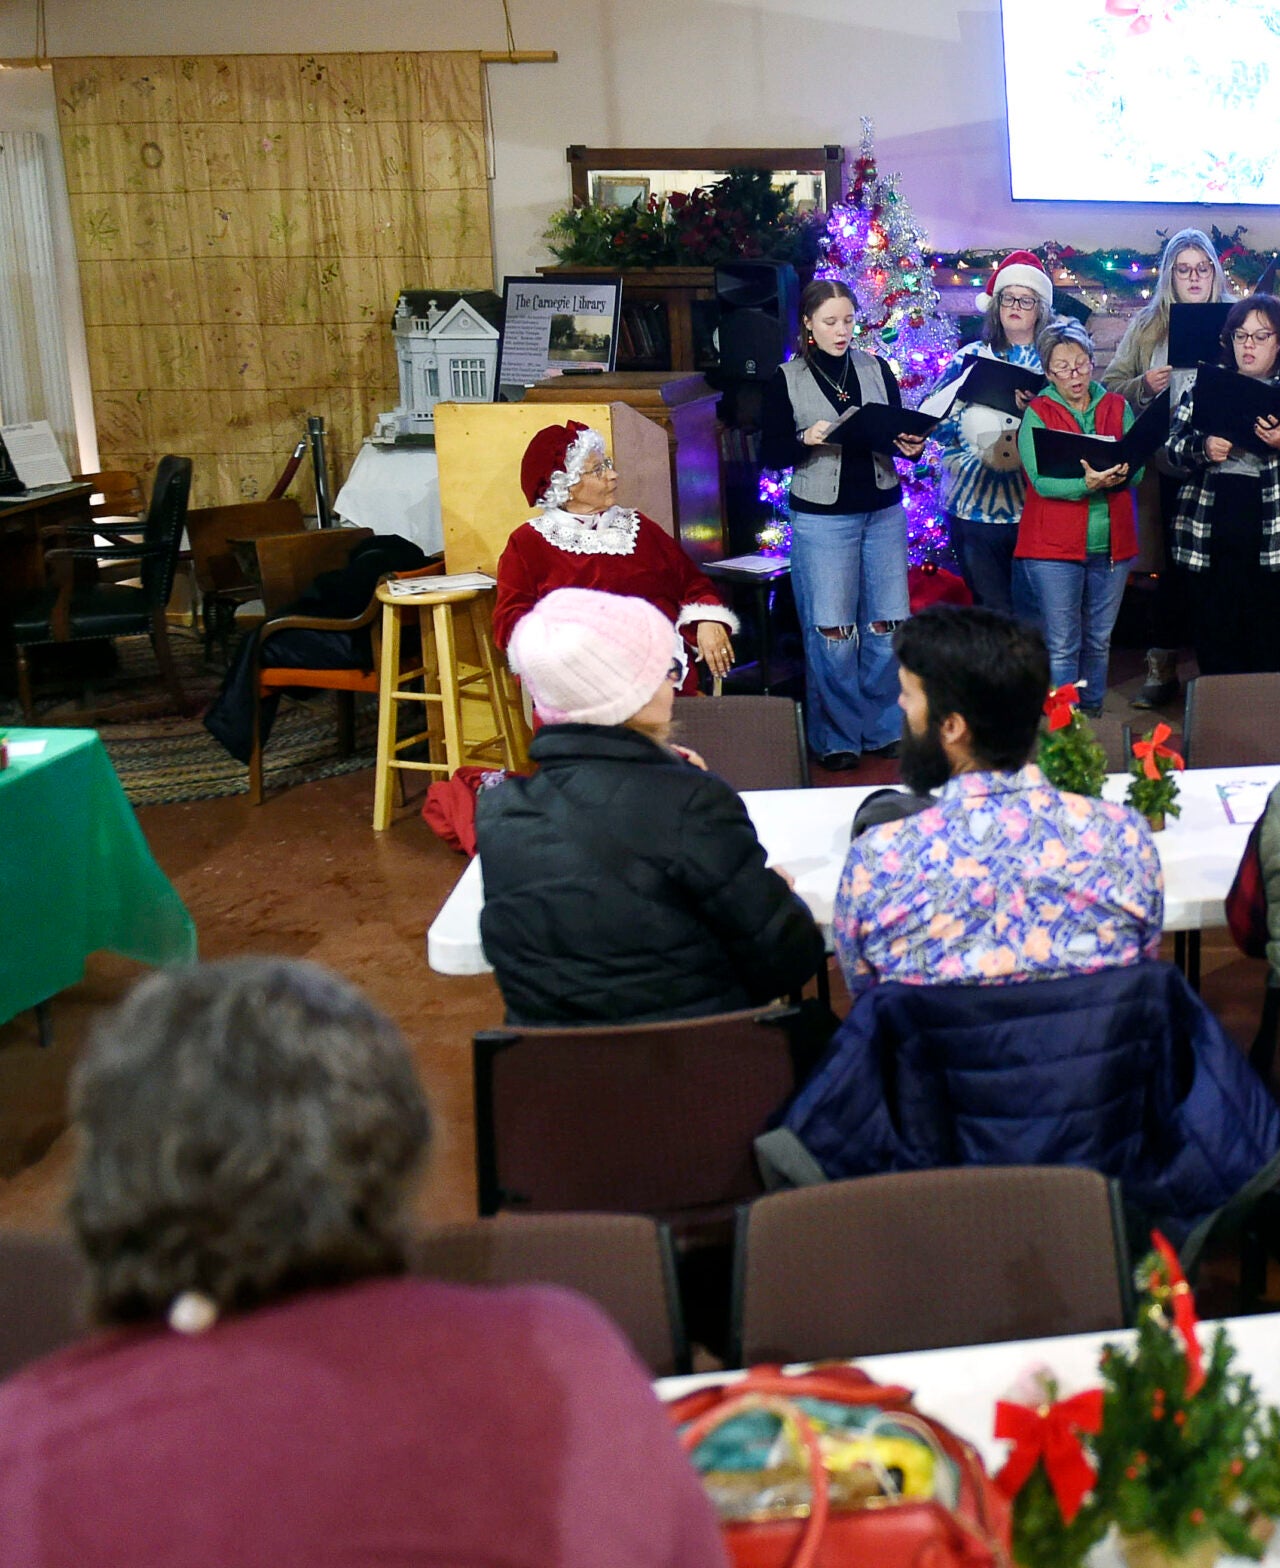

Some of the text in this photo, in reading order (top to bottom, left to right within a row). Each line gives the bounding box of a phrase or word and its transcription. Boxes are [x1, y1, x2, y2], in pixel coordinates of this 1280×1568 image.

[516, 294, 606, 312] The Carnegie Library
